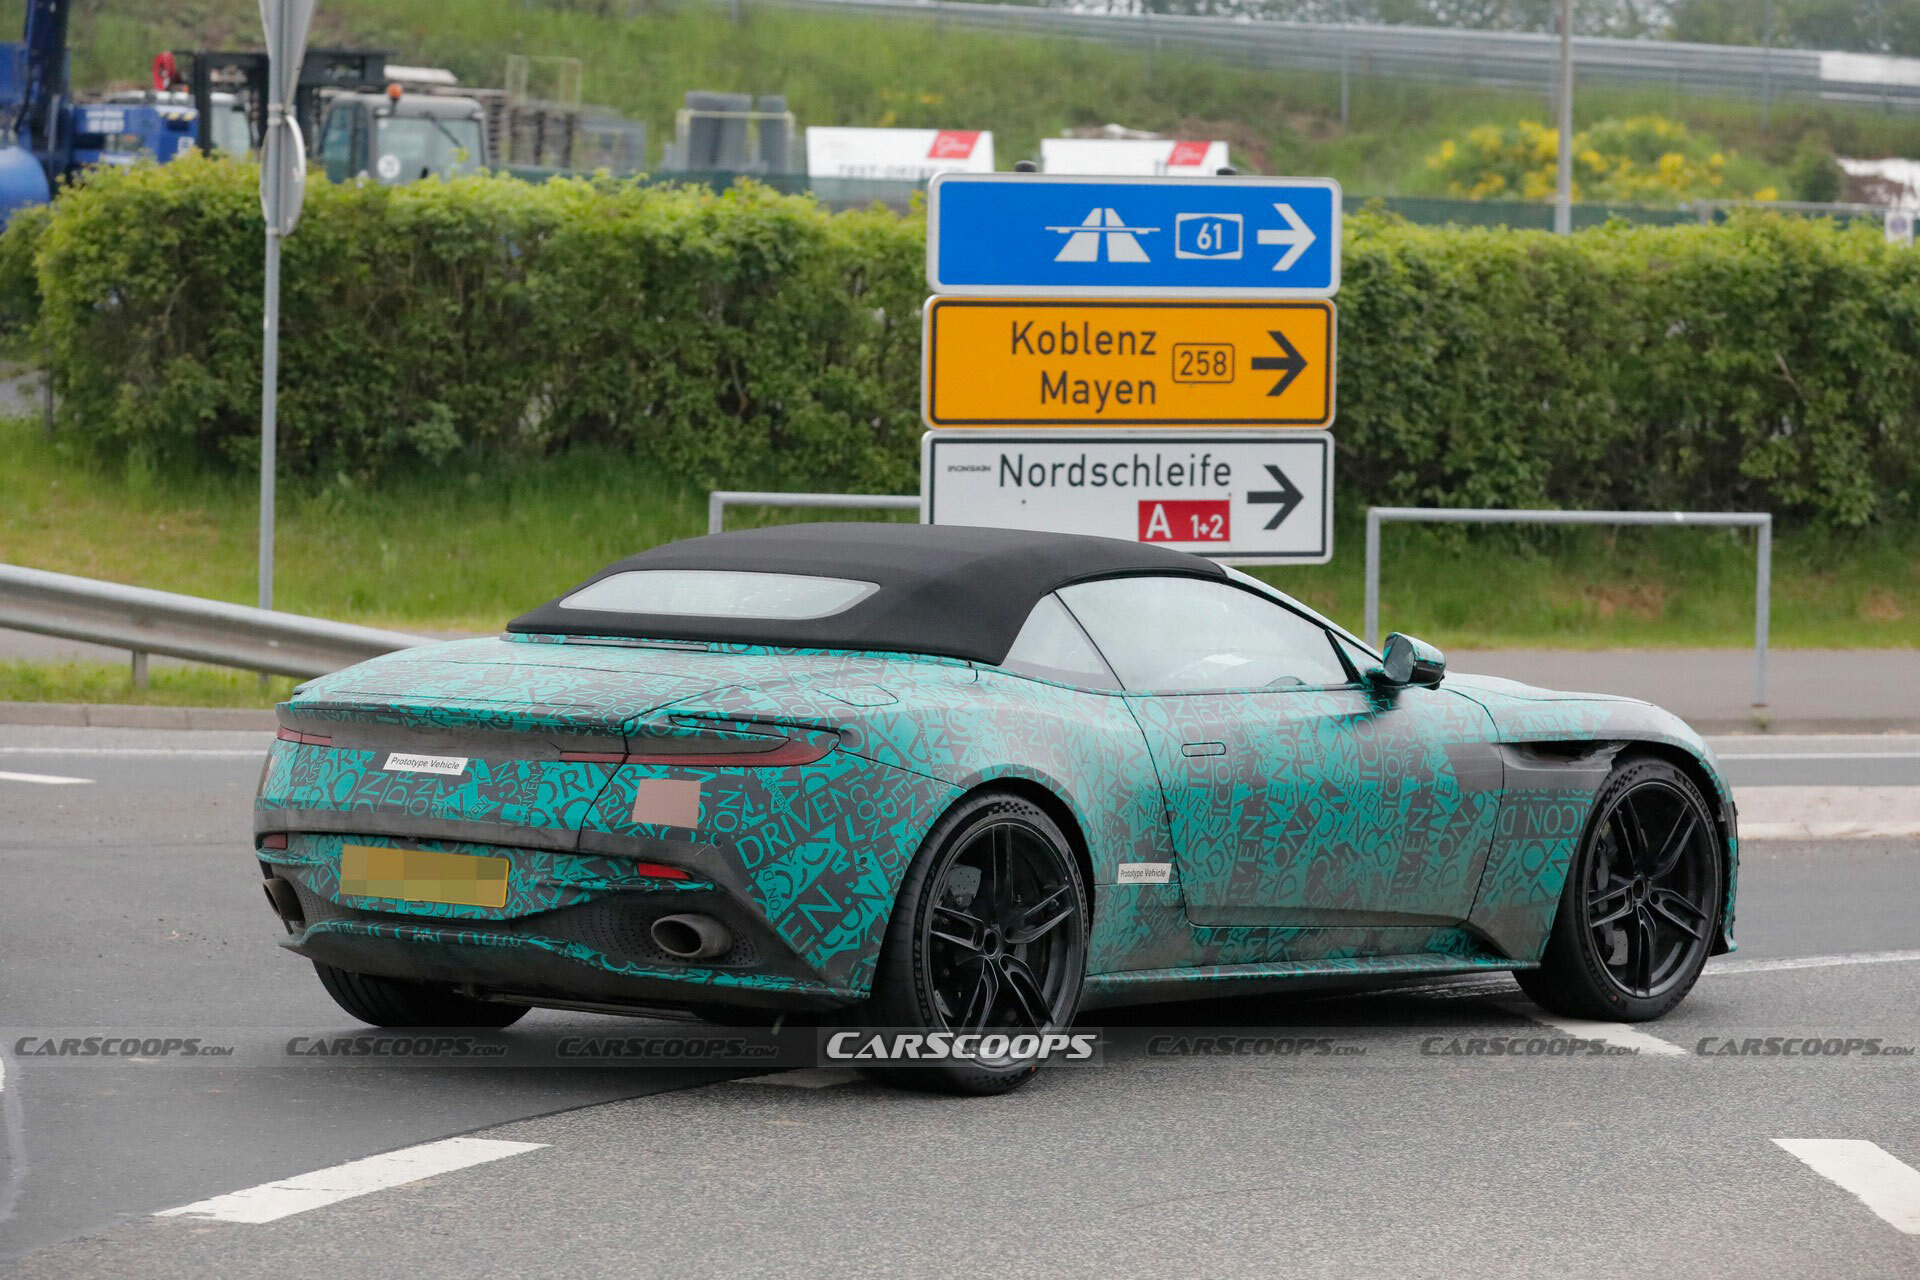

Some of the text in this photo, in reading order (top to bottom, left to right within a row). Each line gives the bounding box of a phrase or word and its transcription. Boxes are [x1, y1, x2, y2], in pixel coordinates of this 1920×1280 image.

[1196, 222, 1222, 250] 61
[1010, 320, 1157, 355] Koblenz
[1179, 351, 1227, 376] 258
[1040, 370, 1156, 414] Mayen
[999, 453, 1231, 487] Nordschleife
[1145, 503, 1223, 539] A 1+2
[390, 756, 460, 770] Prototype Vehicle
[735, 786, 849, 870] DRIVEN
[1120, 868, 1166, 879] Prototype Vehicle
